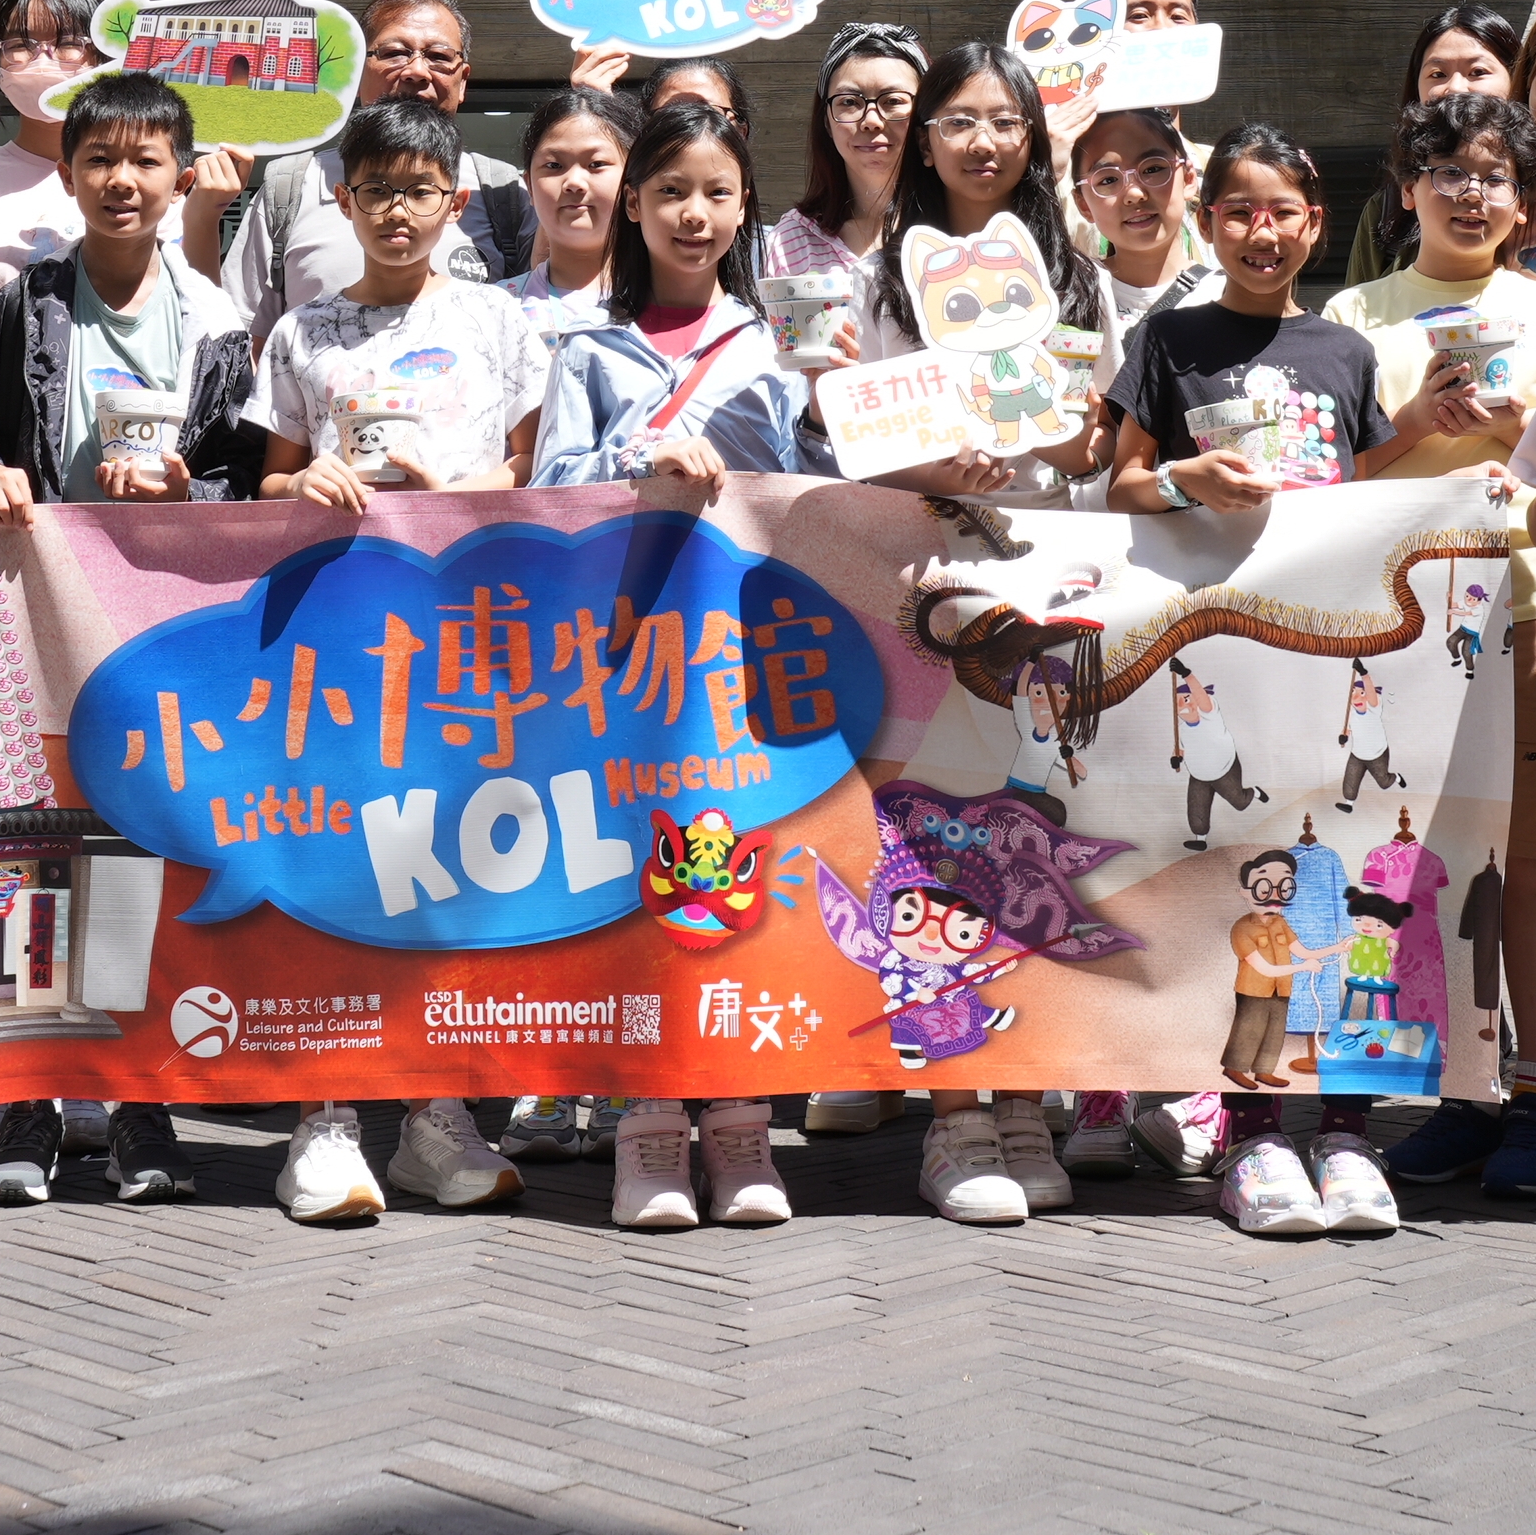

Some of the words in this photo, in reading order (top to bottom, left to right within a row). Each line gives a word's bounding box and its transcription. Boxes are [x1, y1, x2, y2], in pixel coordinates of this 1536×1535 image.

[450, 258, 489, 278] NASA
[846, 364, 947, 414] 活力仔
[1220, 414, 1251, 426] Plant
[120, 582, 837, 795] 小小博物館
[602, 749, 772, 809] Museum
[208, 784, 353, 848] Little
[359, 768, 634, 918] KOL
[244, 992, 382, 1018] 康樂及文化事務署
[424, 991, 452, 1004] LCSD
[424, 990, 617, 1029] edutainment
[245, 1021, 294, 1037] Leisure
[297, 1018, 322, 1034] and
[326, 1016, 383, 1032] Cultural
[426, 1031, 501, 1045] CHANNEL
[505, 1029, 615, 1045] 康文署寓樂頻道
[239, 1037, 296, 1053] Services
[298, 1033, 383, 1055] Department
